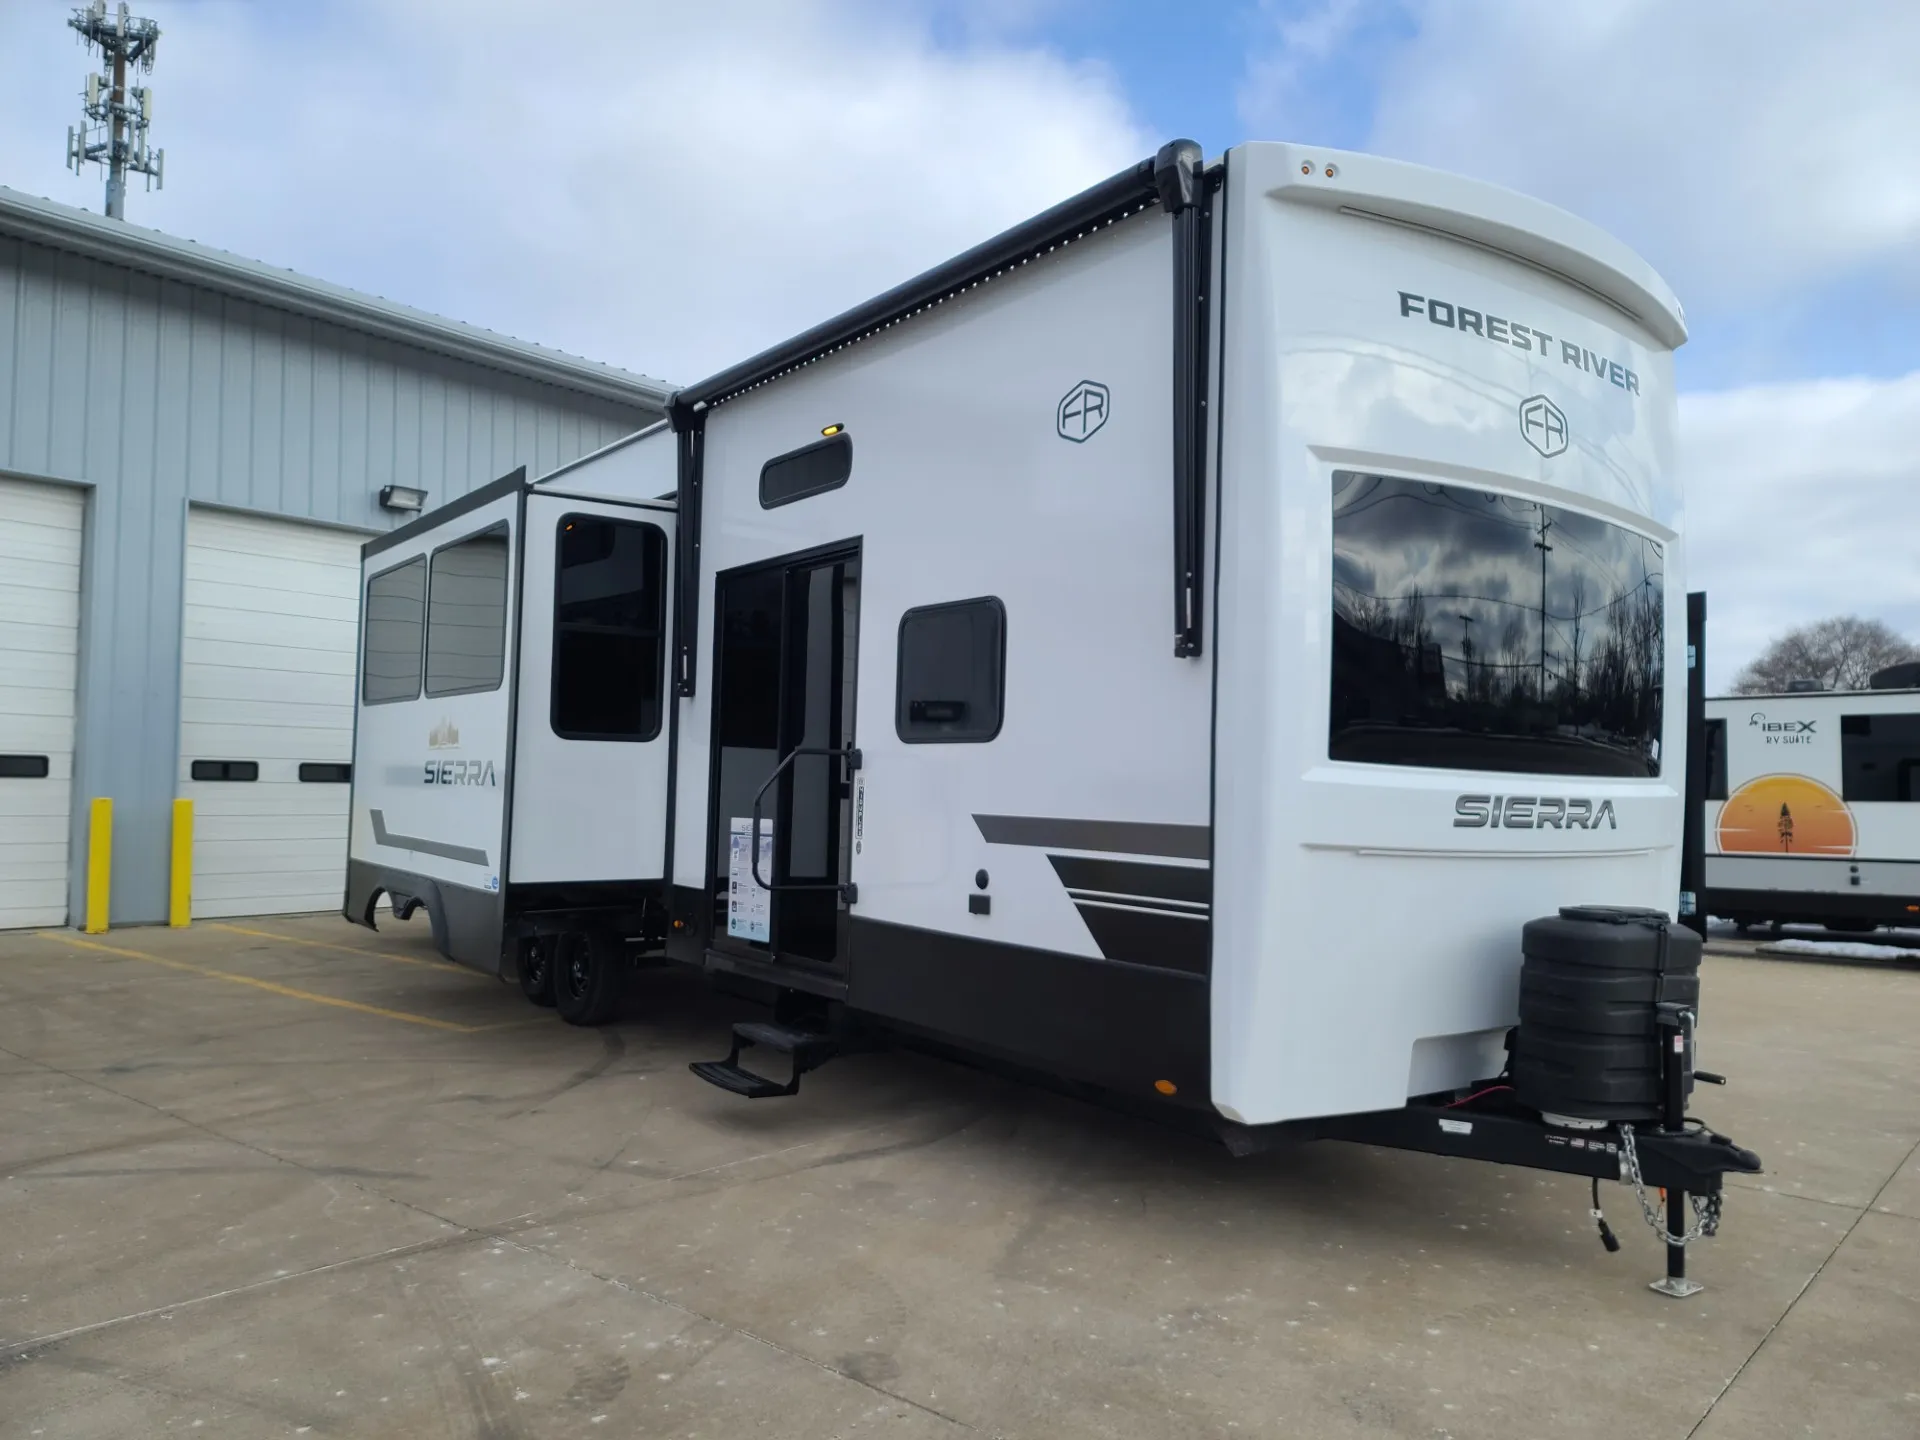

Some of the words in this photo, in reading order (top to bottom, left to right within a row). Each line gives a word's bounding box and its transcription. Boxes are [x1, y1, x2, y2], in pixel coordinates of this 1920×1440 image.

[1397, 290, 1553, 357] FOREST
[1559, 338, 1640, 397] RIVER
[1766, 736, 1780, 744] RV
[1783, 733, 1812, 744] SUITE
[423, 759, 496, 787] SIERRA
[1453, 793, 1617, 830] SIERRA
